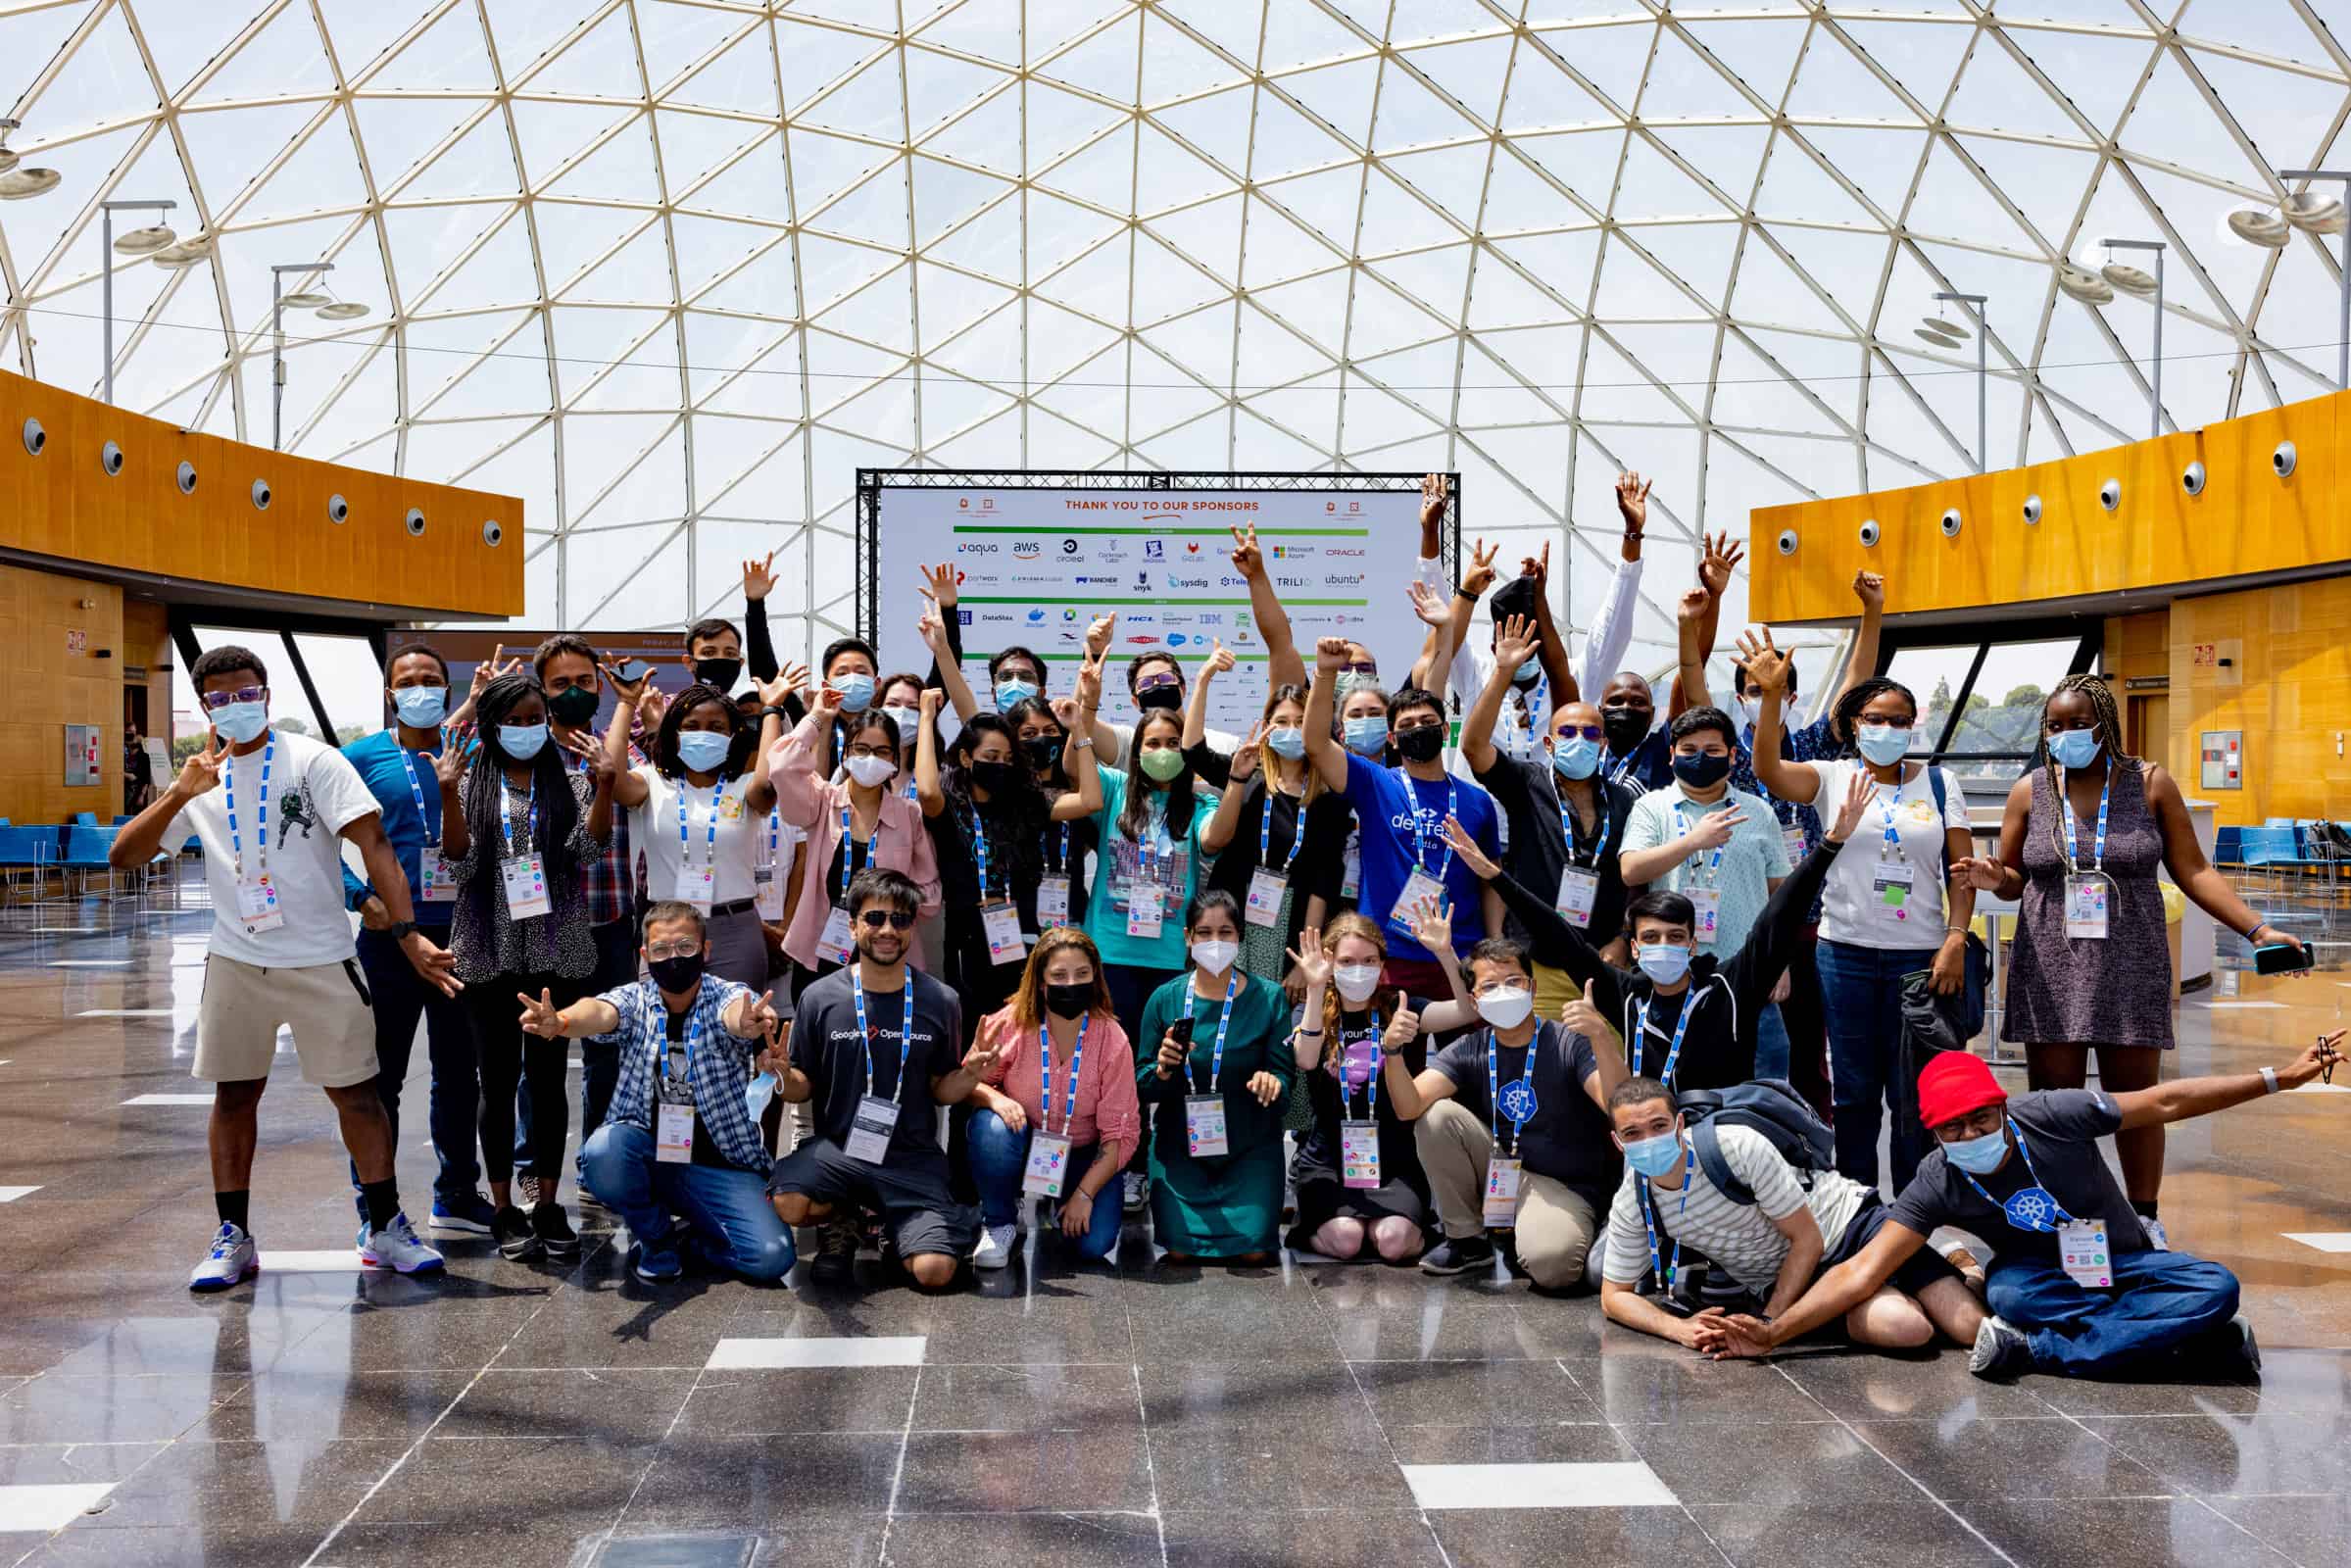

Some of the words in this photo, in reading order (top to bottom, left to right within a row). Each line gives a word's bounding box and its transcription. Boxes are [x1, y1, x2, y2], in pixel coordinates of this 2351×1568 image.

[1066, 500, 1107, 511] THANK
[1112, 501, 1138, 511] YOU
[1143, 501, 1159, 511] TO
[1162, 501, 1189, 511] OUR
[1192, 501, 1259, 511] SPONSORS
[967, 543, 999, 556] aqua
[1013, 542, 1040, 553] aws
[1180, 578, 1208, 588] sysdig
[1325, 574, 1360, 584] ubuntu
[1200, 613, 1223, 624] IBM
[1411, 837, 1438, 850] Idia
[830, 1028, 860, 1042] Google
[880, 1029, 904, 1040] Open
[909, 1033, 933, 1042] ource
